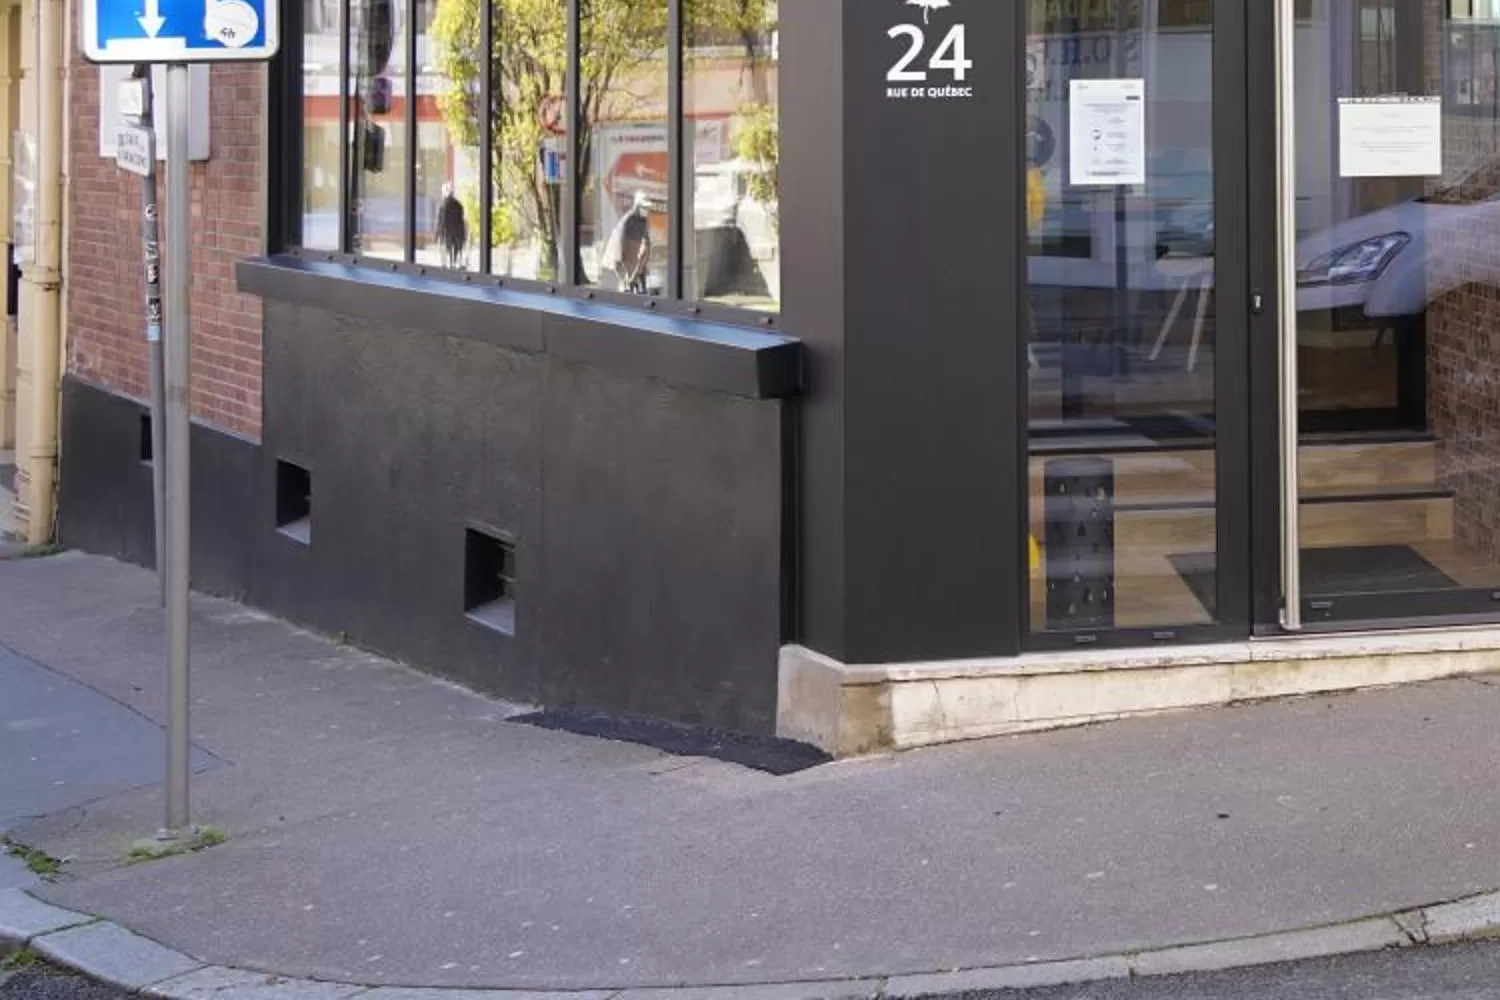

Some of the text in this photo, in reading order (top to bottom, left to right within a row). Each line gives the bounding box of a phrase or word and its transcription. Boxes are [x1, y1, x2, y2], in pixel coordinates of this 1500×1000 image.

[886, 23, 973, 81] 24
[886, 84, 974, 98] RUE DE QUÉBEC
